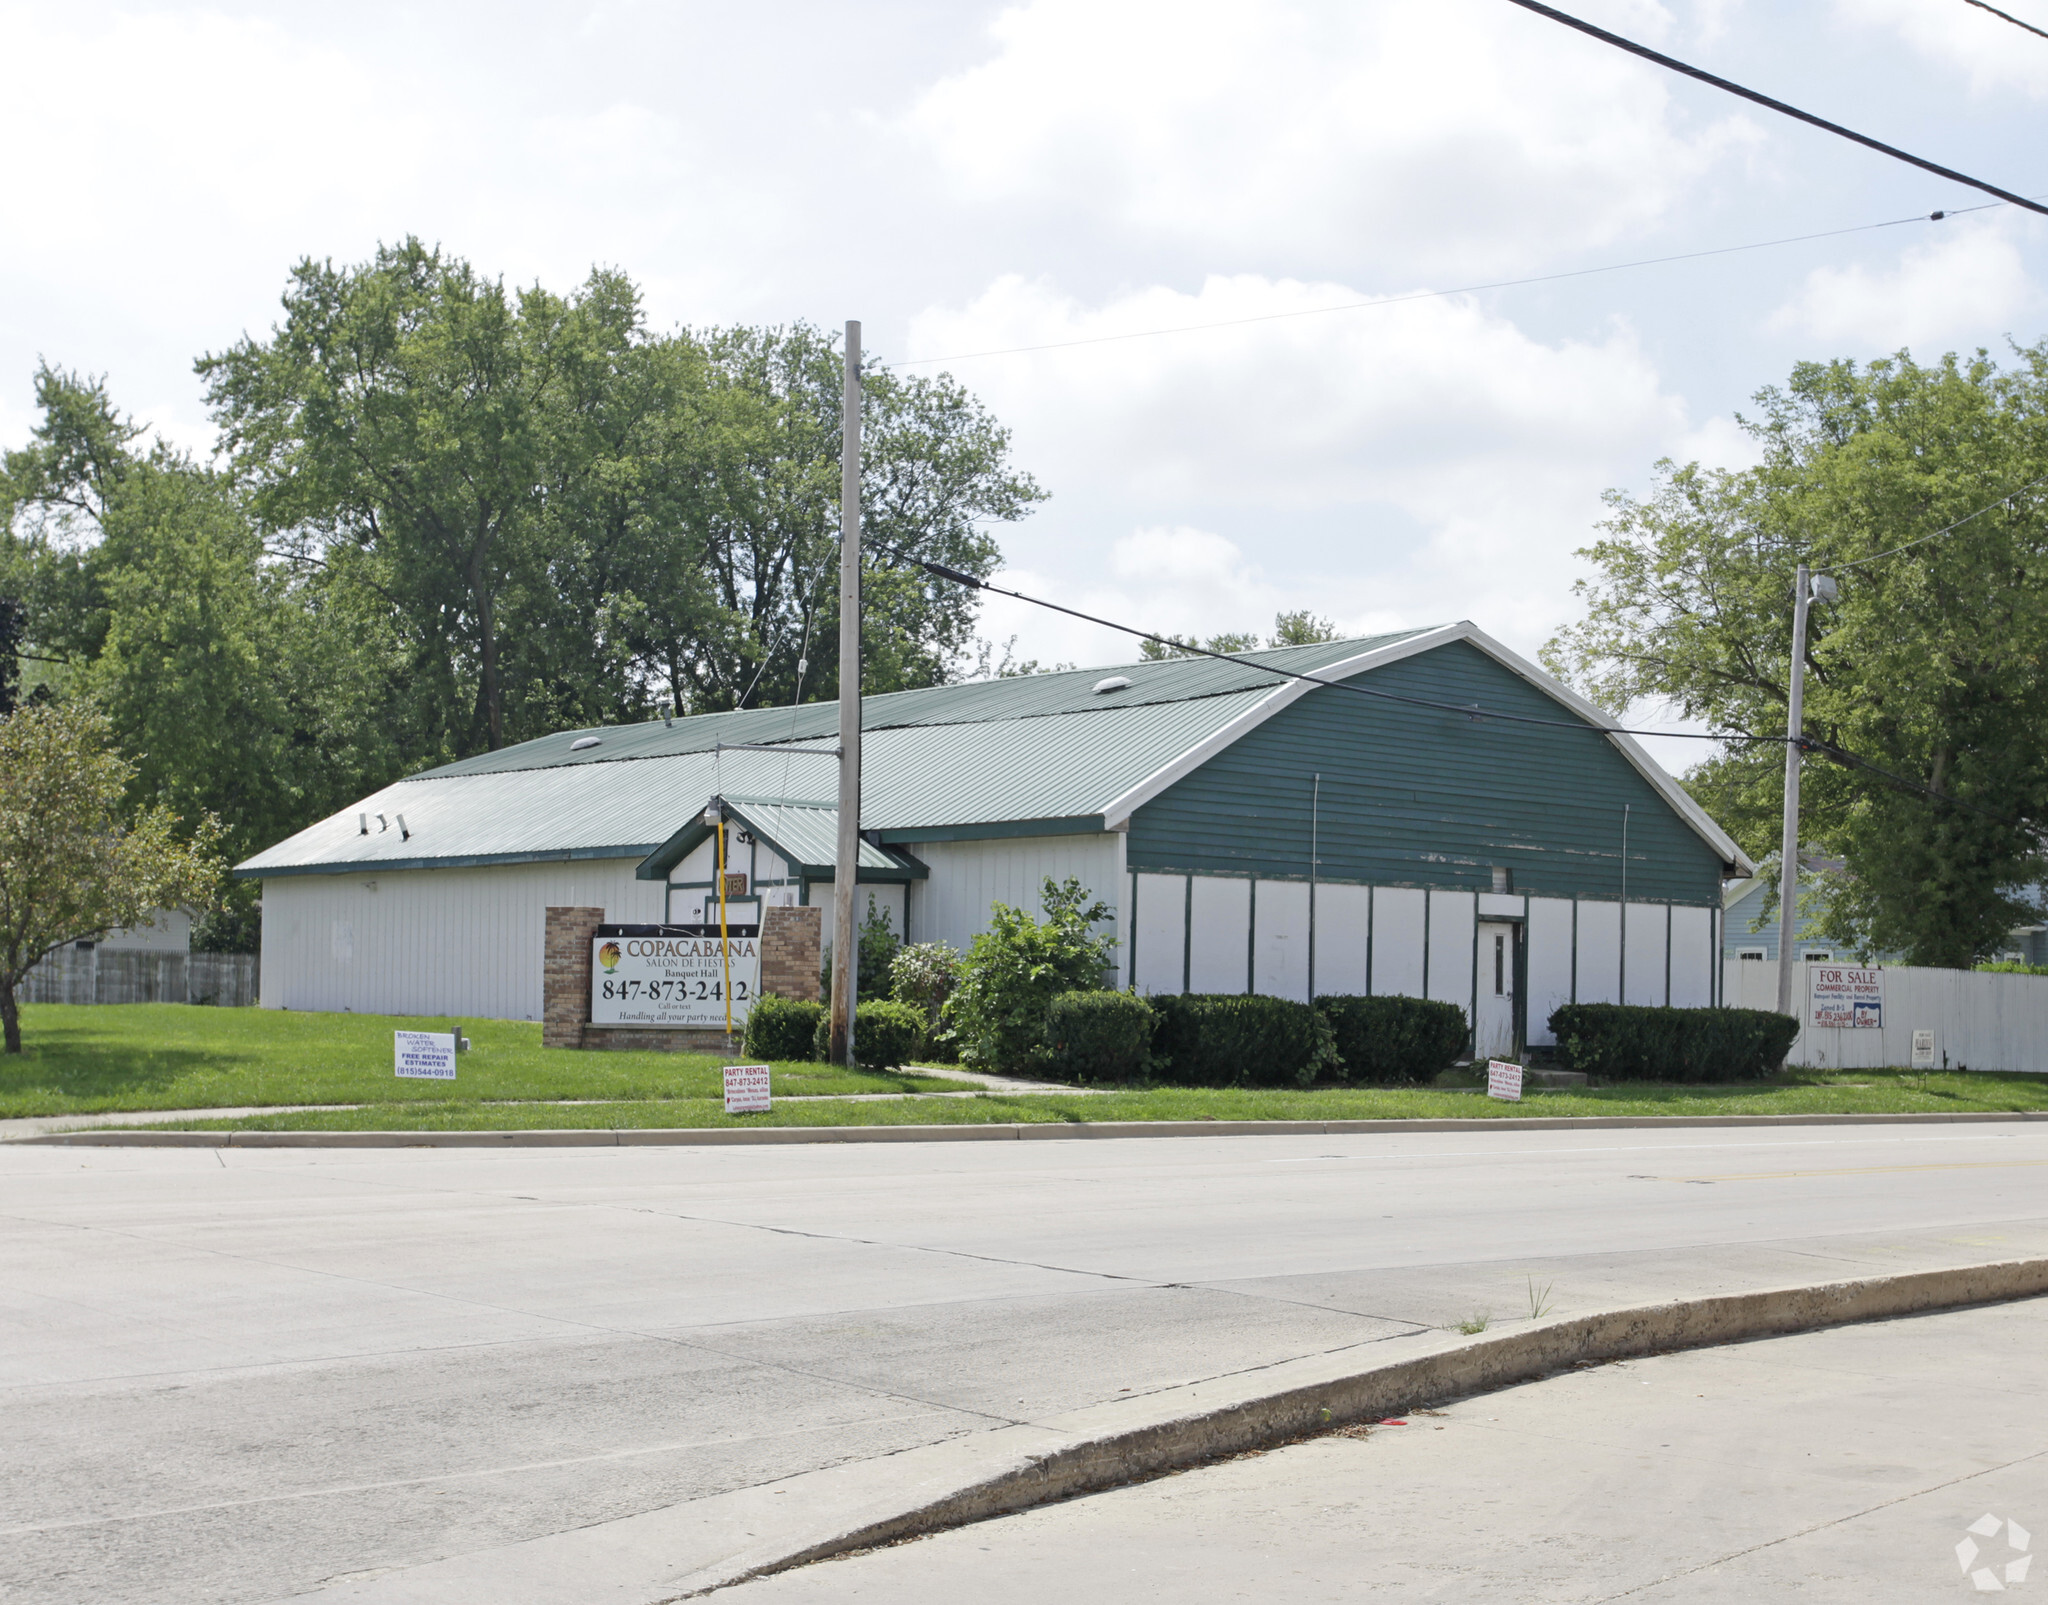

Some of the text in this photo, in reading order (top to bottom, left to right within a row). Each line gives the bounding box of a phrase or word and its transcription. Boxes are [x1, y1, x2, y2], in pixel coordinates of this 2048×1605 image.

[627, 940, 756, 957] COPACABANA
[646, 958, 736, 967] SALON DE FIESTS
[665, 969, 718, 979] Banquet Hall
[1820, 970, 1876, 984] FOR SALE
[602, 980, 748, 1001] 847-873-2412
[1816, 983, 1879, 993] COMMERCIAL PROPERTY
[619, 1011, 655, 1022] Handling
[656, 1012, 667, 1020] all
[667, 1014, 686, 1022] your
[687, 1014, 708, 1022] party
[397, 1032, 430, 1040] BROKEN
[411, 1046, 453, 1054] SOFTENER
[397, 1067, 454, 1077] (815)544-0918
[725, 1067, 768, 1076] PARTY RENTAL
[1490, 1062, 1521, 1073] PARTY RENTAL
[725, 1077, 768, 1087] 847-873-2412
